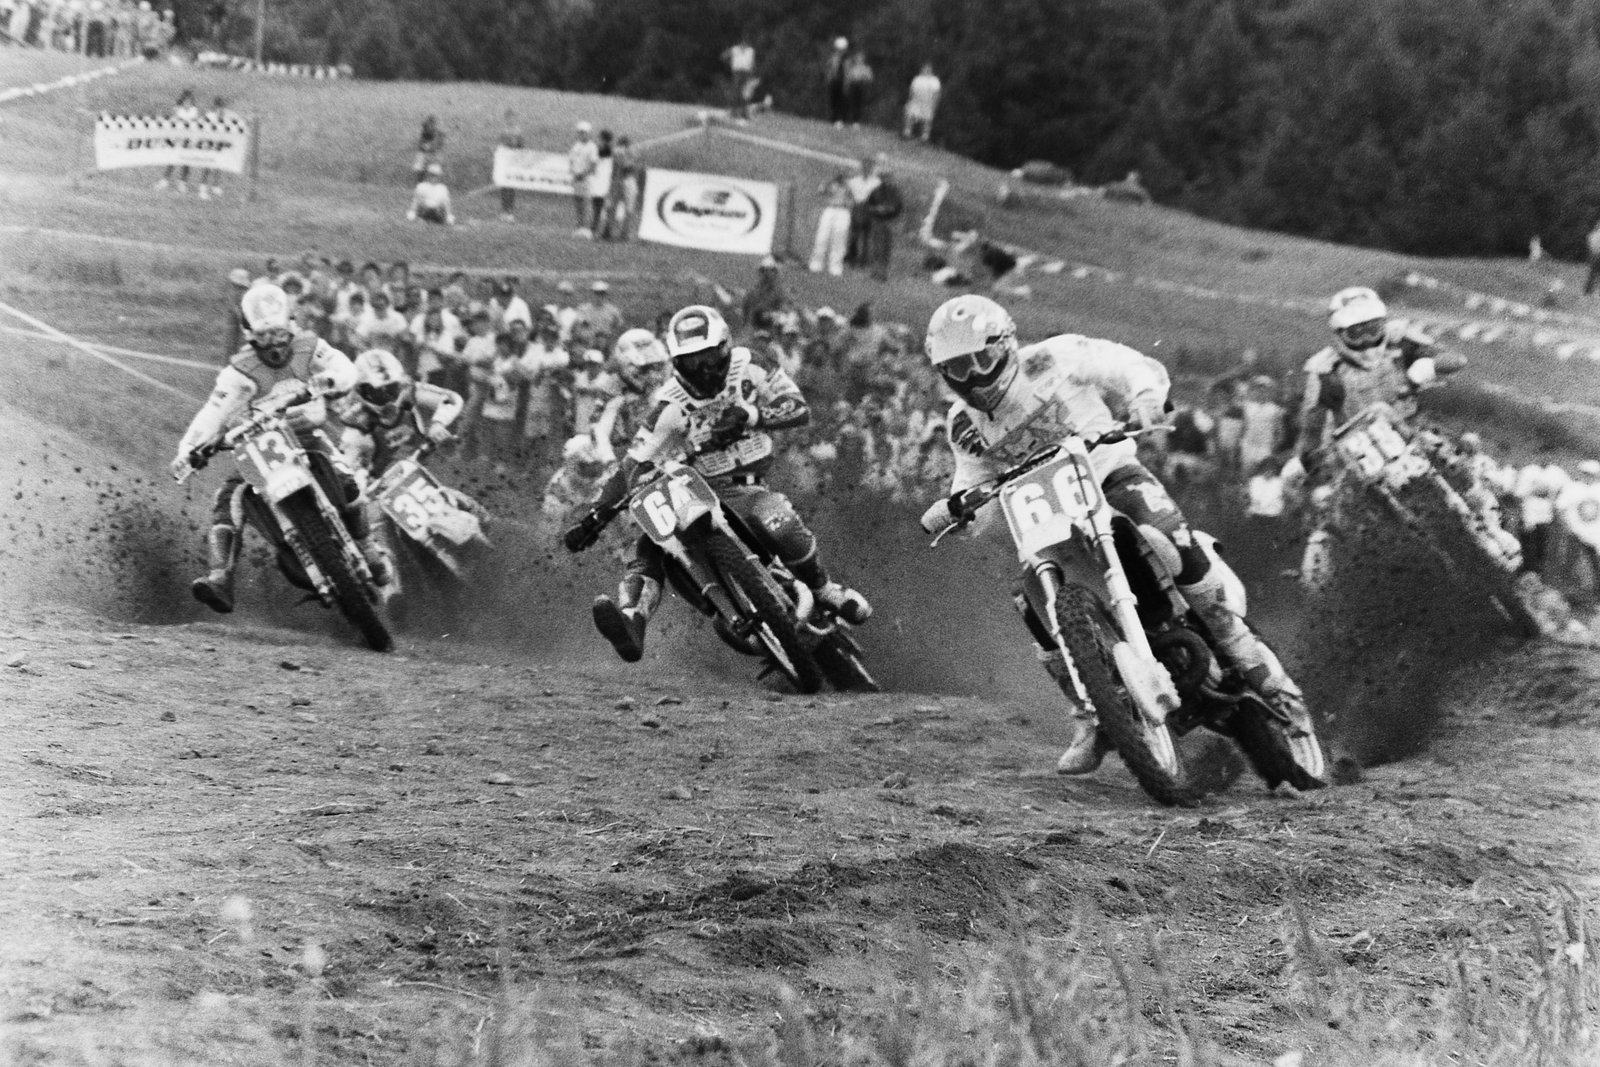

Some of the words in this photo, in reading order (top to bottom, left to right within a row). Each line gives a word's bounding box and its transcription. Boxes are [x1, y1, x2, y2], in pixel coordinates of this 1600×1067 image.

[127, 137, 232, 151] DUNLOP
[246, 431, 293, 477] 13
[393, 477, 447, 530] 35
[1010, 463, 1099, 534] 66
